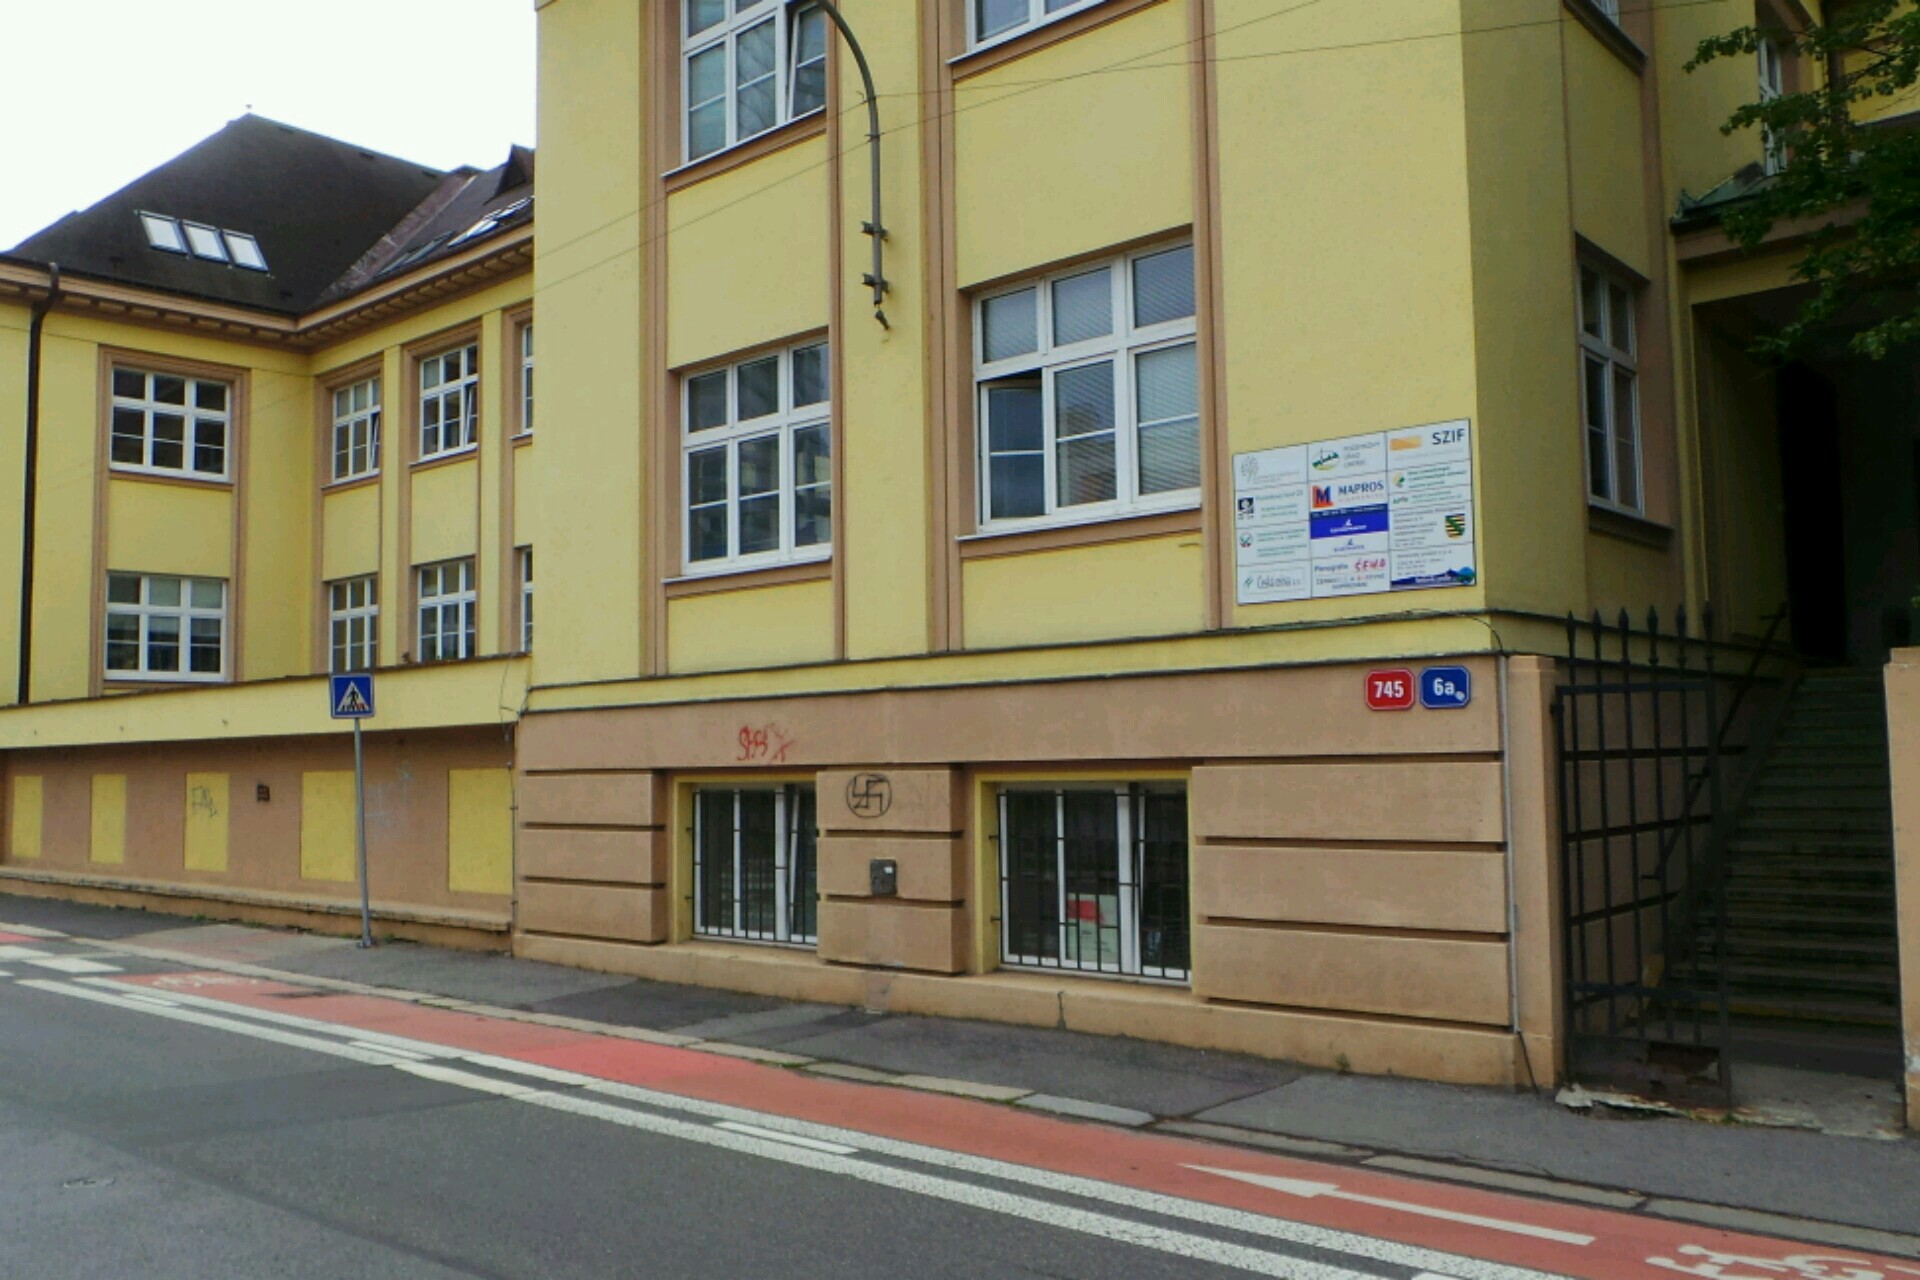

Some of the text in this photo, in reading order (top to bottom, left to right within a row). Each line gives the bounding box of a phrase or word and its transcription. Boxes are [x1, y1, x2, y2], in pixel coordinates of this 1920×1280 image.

[1432, 428, 1465, 445] SZIF
[1339, 481, 1384, 496] MAPROS
[1373, 681, 1404, 699] 745
[1433, 678, 1455, 696] 6a
